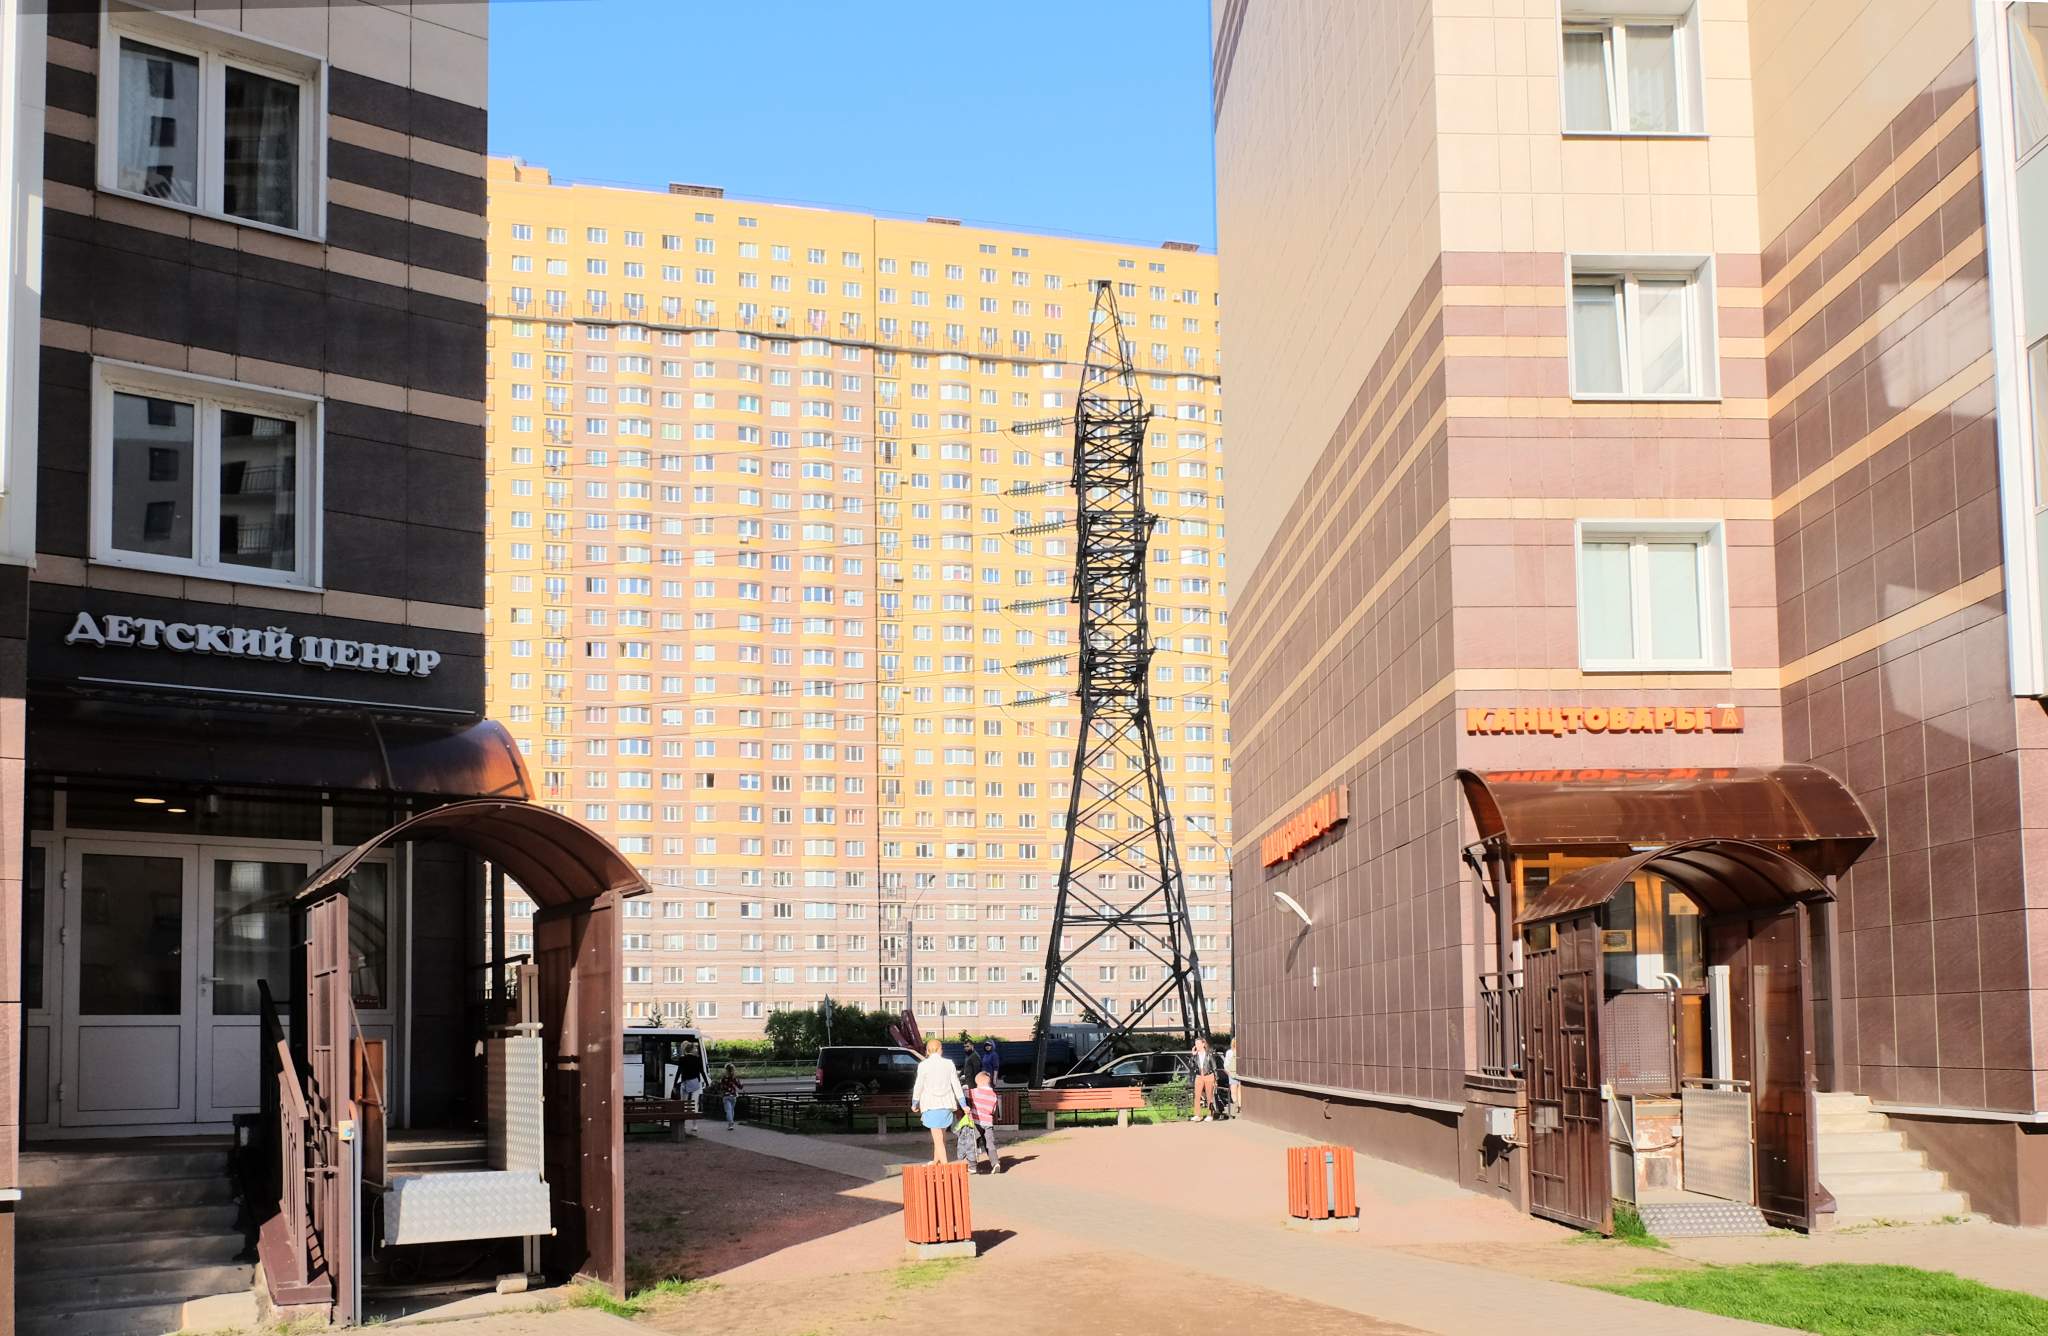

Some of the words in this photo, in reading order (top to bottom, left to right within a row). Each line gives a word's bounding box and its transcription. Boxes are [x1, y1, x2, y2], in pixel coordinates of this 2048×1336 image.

[65, 611, 294, 661] ДЕТСКИЙ
[299, 636, 441, 676] ЦЕНТР
[1467, 707, 1705, 737] КАНЦТОВАРЫ
